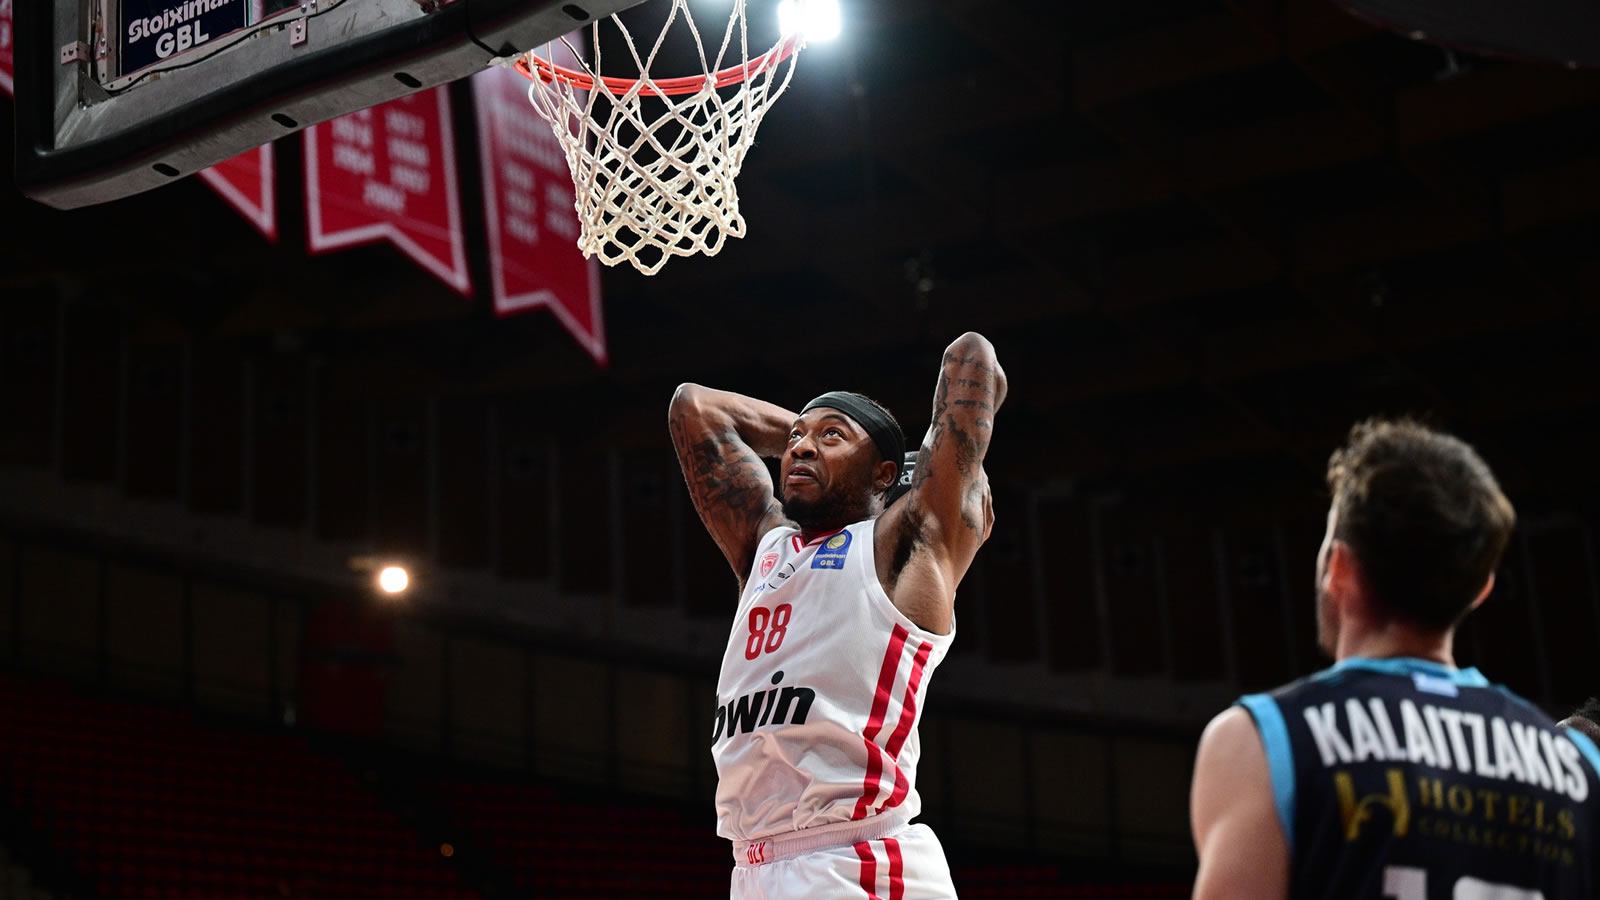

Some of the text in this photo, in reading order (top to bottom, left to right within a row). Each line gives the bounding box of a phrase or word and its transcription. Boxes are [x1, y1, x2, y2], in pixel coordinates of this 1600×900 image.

[128, 0, 235, 44] Stoixima
[155, 20, 209, 59] GBL
[744, 603, 792, 661] 88
[1304, 698, 1588, 802] KALAITZAKIS
[1418, 777, 1576, 840] HOTELS
